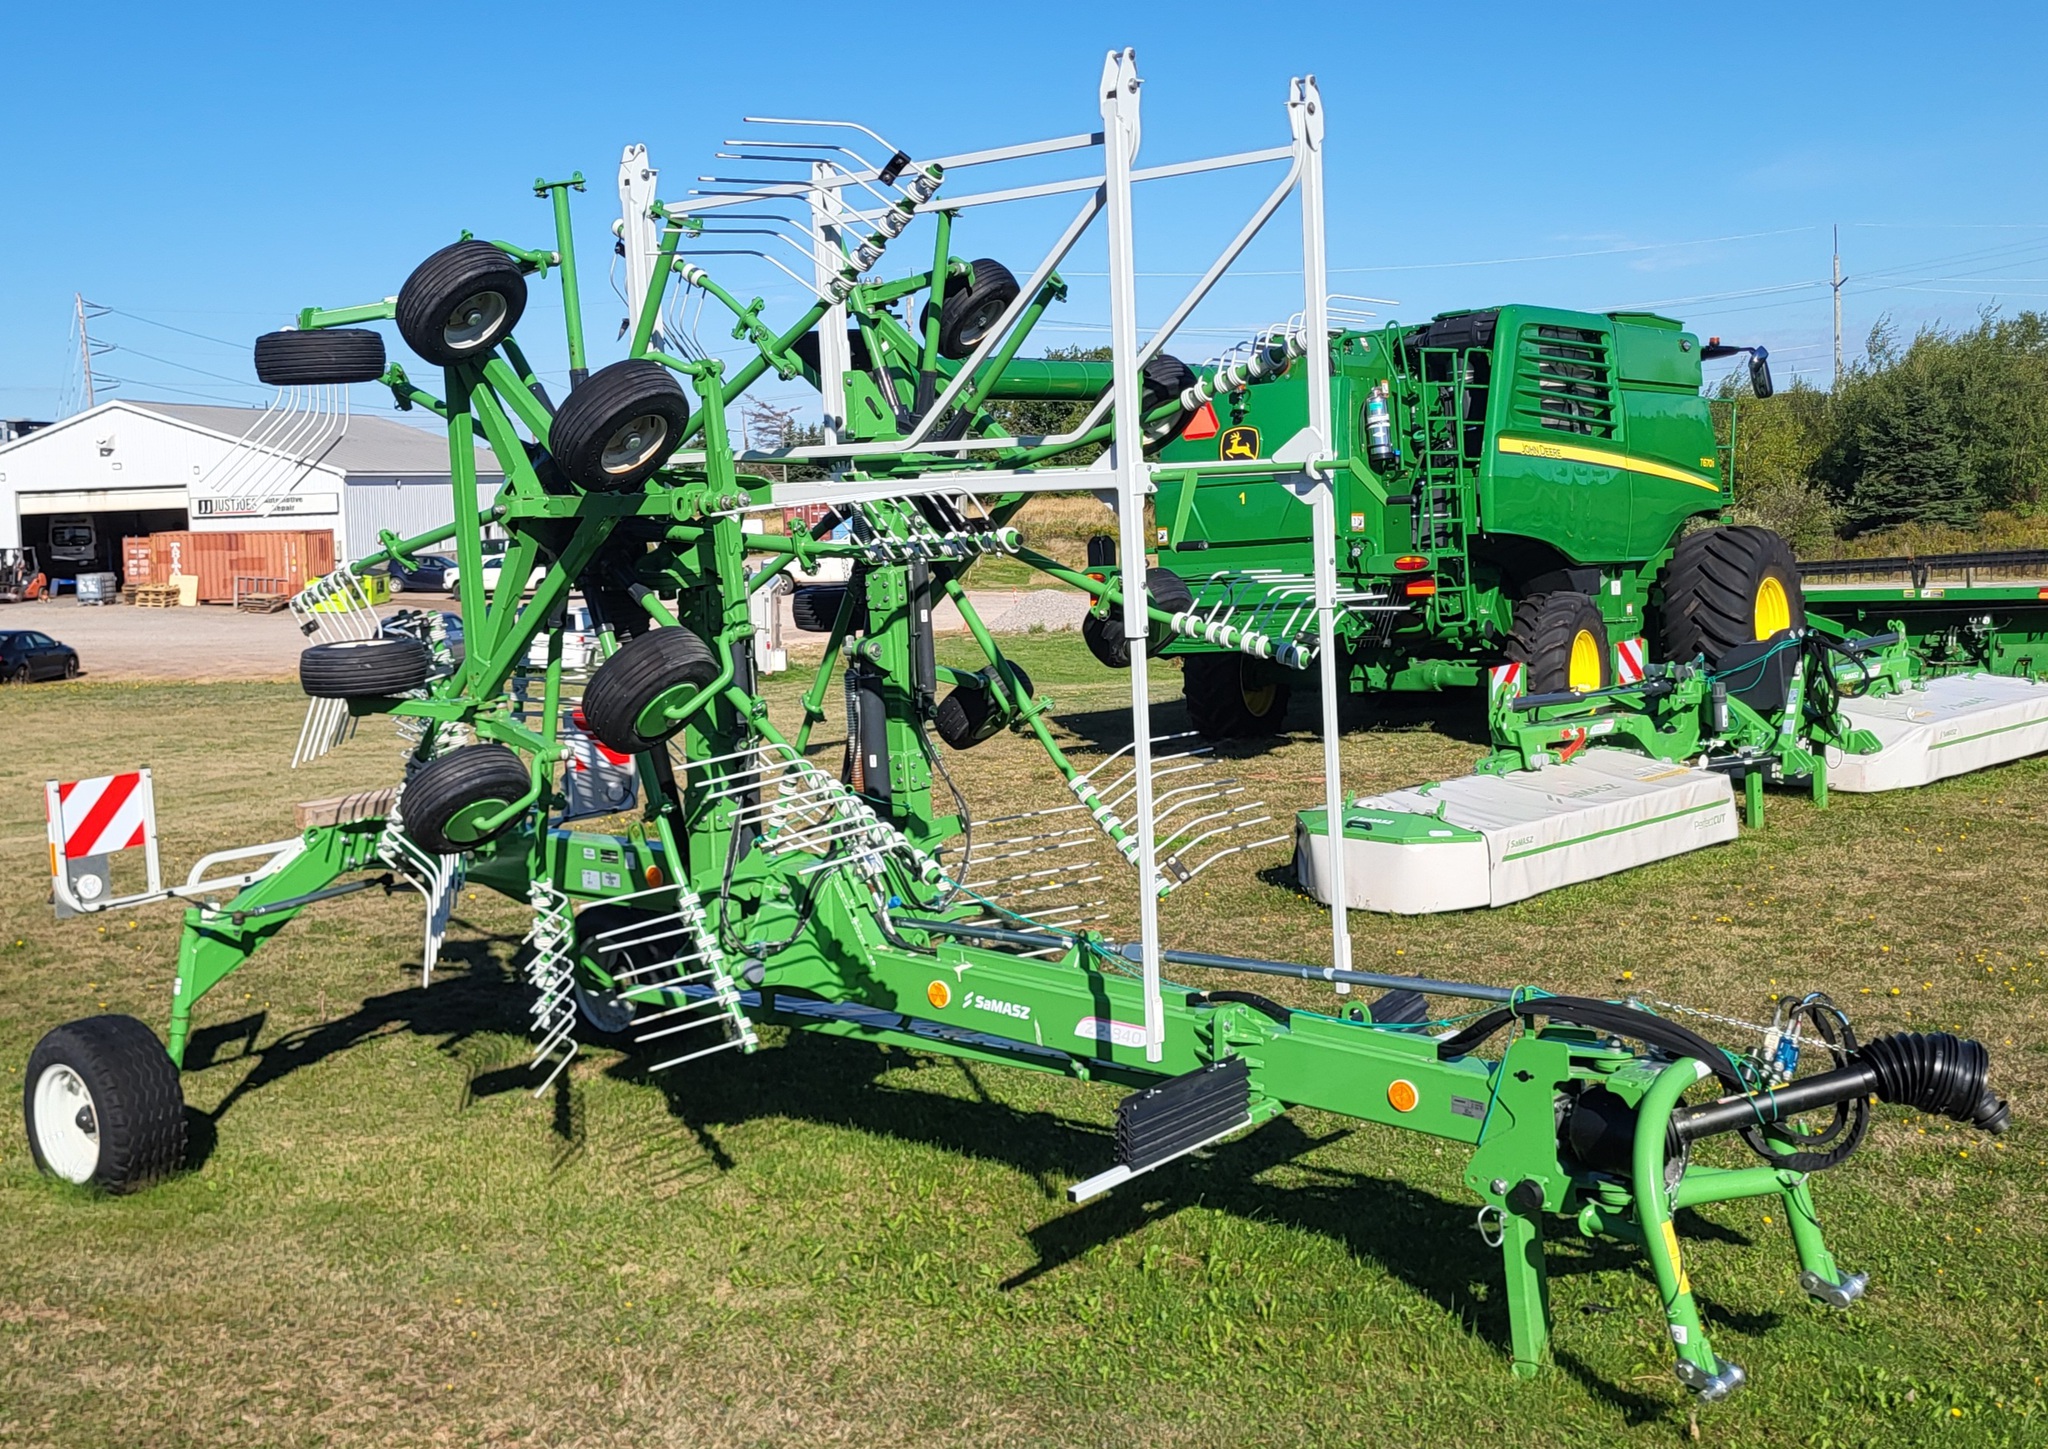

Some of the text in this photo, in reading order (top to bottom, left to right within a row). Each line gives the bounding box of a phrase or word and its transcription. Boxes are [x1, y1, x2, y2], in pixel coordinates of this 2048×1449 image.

[1521, 442, 1562, 458] JOHN DEERE
[1238, 492, 1245, 505] 1
[272, 504, 295, 512] epair
[974, 996, 1031, 1020] SaMASZ
